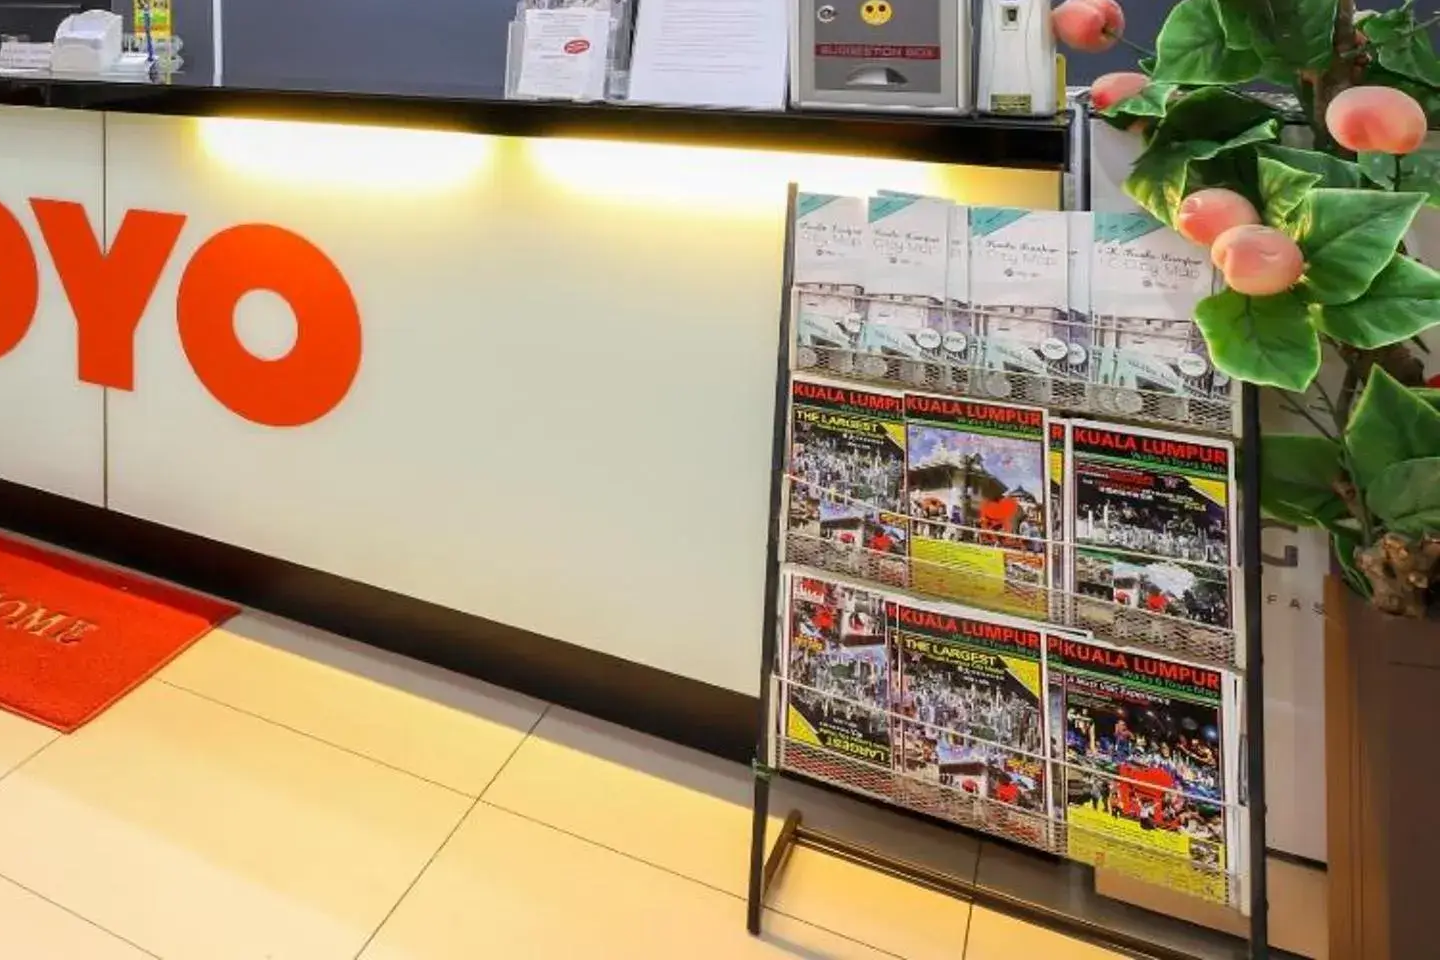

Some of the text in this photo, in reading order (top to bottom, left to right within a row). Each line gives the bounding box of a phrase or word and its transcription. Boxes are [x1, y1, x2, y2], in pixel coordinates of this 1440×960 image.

[794, 382, 845, 402] KUALA
[907, 397, 962, 416] KUALA
[967, 406, 1042, 426] LUMPUR
[1075, 429, 1137, 451] KUALA
[1142, 438, 1226, 465] LUMPUR
[900, 607, 957, 632] KUALA
[962, 620, 1040, 648] LUMPUR
[1064, 642, 1128, 669] KUALA
[1133, 656, 1220, 689] LUMPUR
